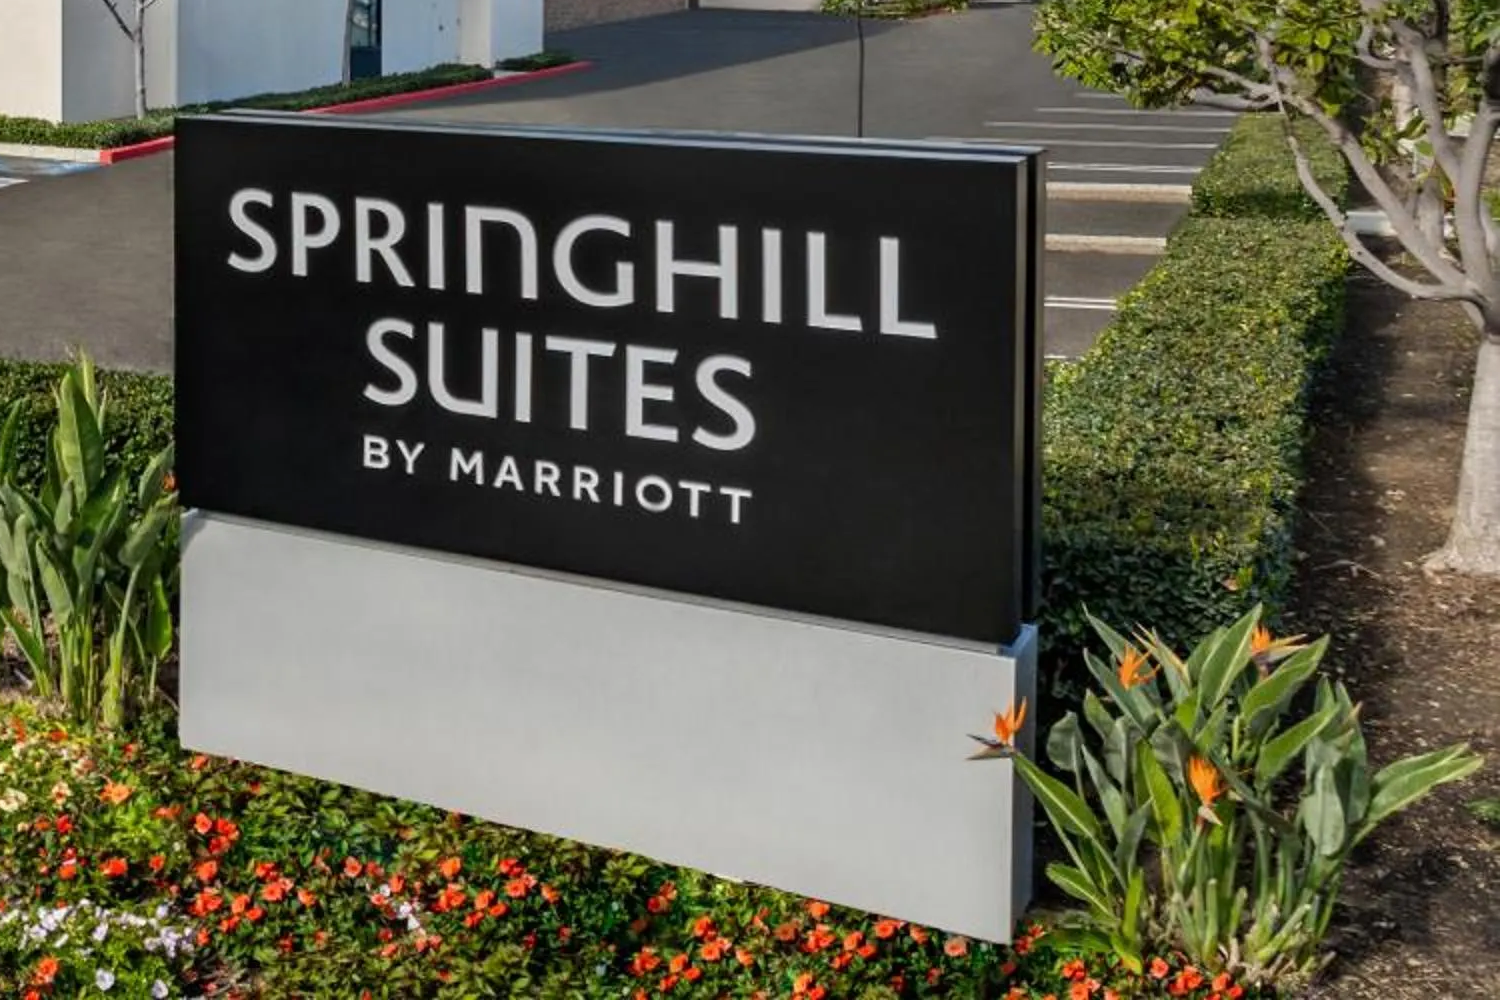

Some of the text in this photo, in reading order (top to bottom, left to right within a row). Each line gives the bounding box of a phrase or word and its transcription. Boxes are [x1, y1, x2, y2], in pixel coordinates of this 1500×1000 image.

[227, 188, 937, 340] SPRINGHILL
[363, 317, 757, 451] SUITES
[363, 434, 753, 524] BY MARRIOTT
